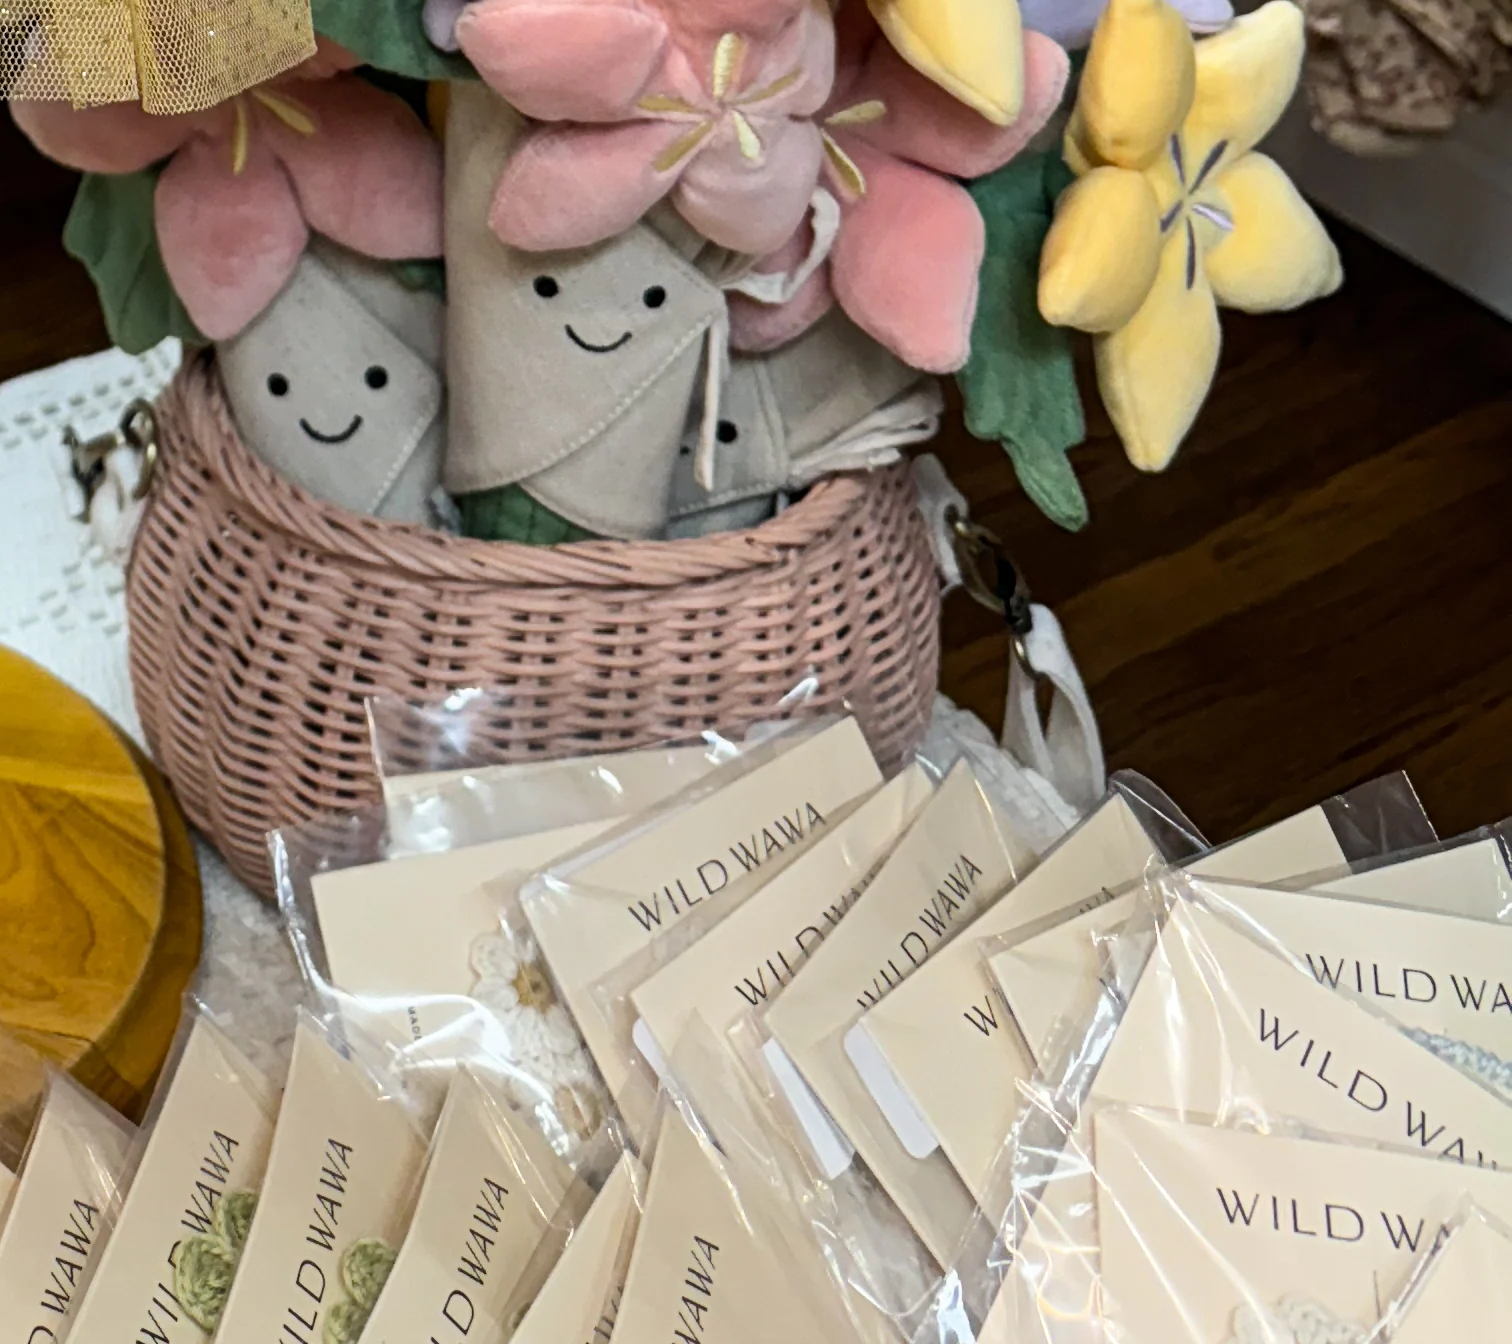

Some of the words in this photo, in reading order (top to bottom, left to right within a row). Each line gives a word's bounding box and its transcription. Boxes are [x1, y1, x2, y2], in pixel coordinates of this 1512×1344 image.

[627, 859, 729, 931] WILD
[728, 802, 827, 872] WAWA
[919, 855, 982, 937] WAWA
[1305, 953, 1437, 1003] WILD
[1259, 1008, 1388, 1112] WILD
[180, 1130, 240, 1234] WAWA
[305, 1138, 354, 1252] WAWA
[457, 1177, 510, 1286] WAWA
[1215, 1187, 1364, 1243] WILD
[40, 1198, 101, 1315] WAWA
